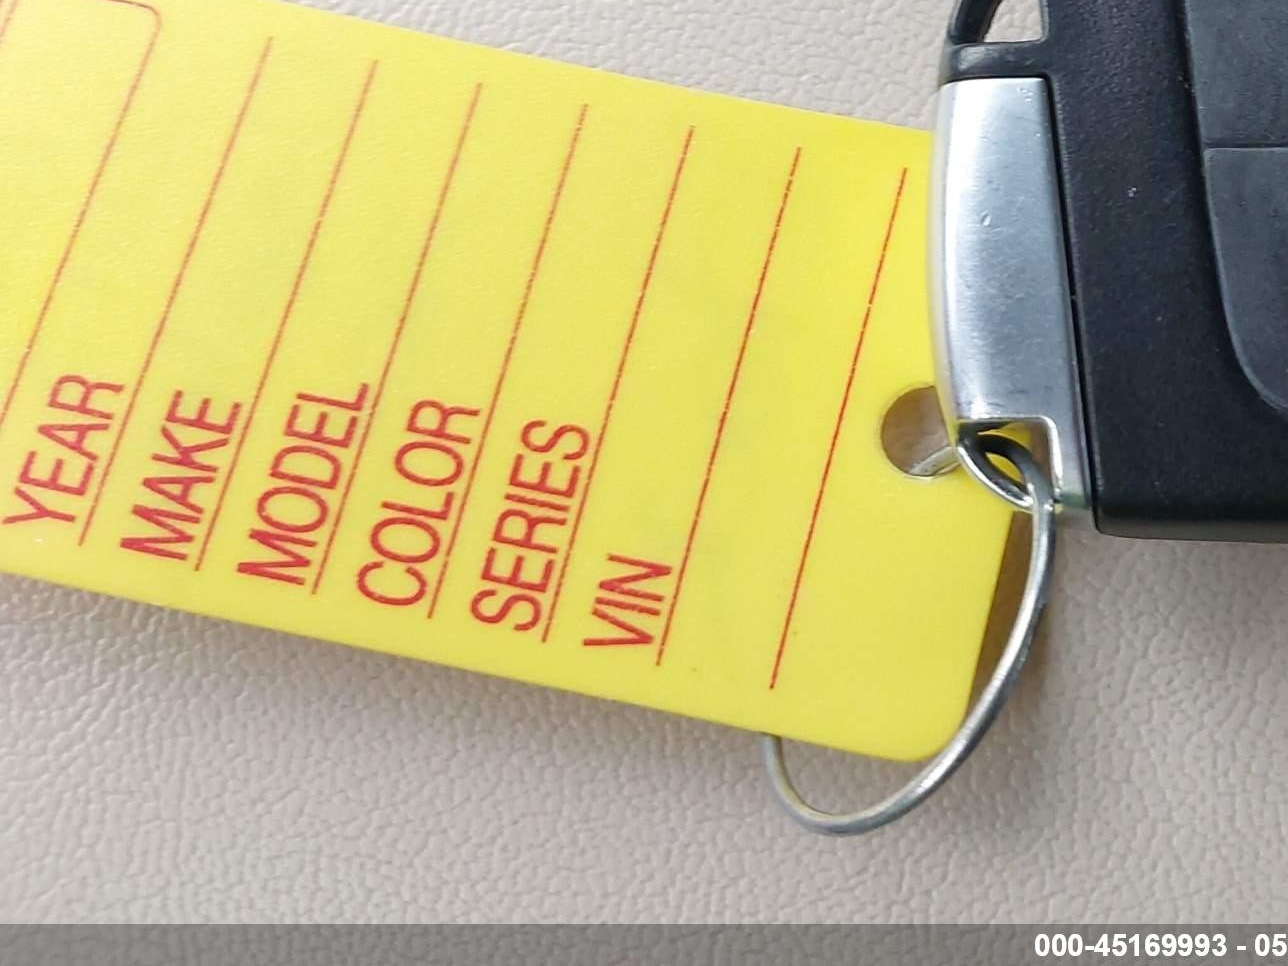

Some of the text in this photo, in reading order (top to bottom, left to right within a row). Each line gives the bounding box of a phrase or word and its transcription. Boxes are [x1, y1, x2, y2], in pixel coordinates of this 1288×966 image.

[3, 373, 125, 527] YEAR
[119, 389, 243, 560] MAKE
[236, 382, 370, 586] MODEL
[356, 399, 481, 607] COLOR
[470, 419, 590, 632] SERIES
[582, 552, 673, 650] VIN
